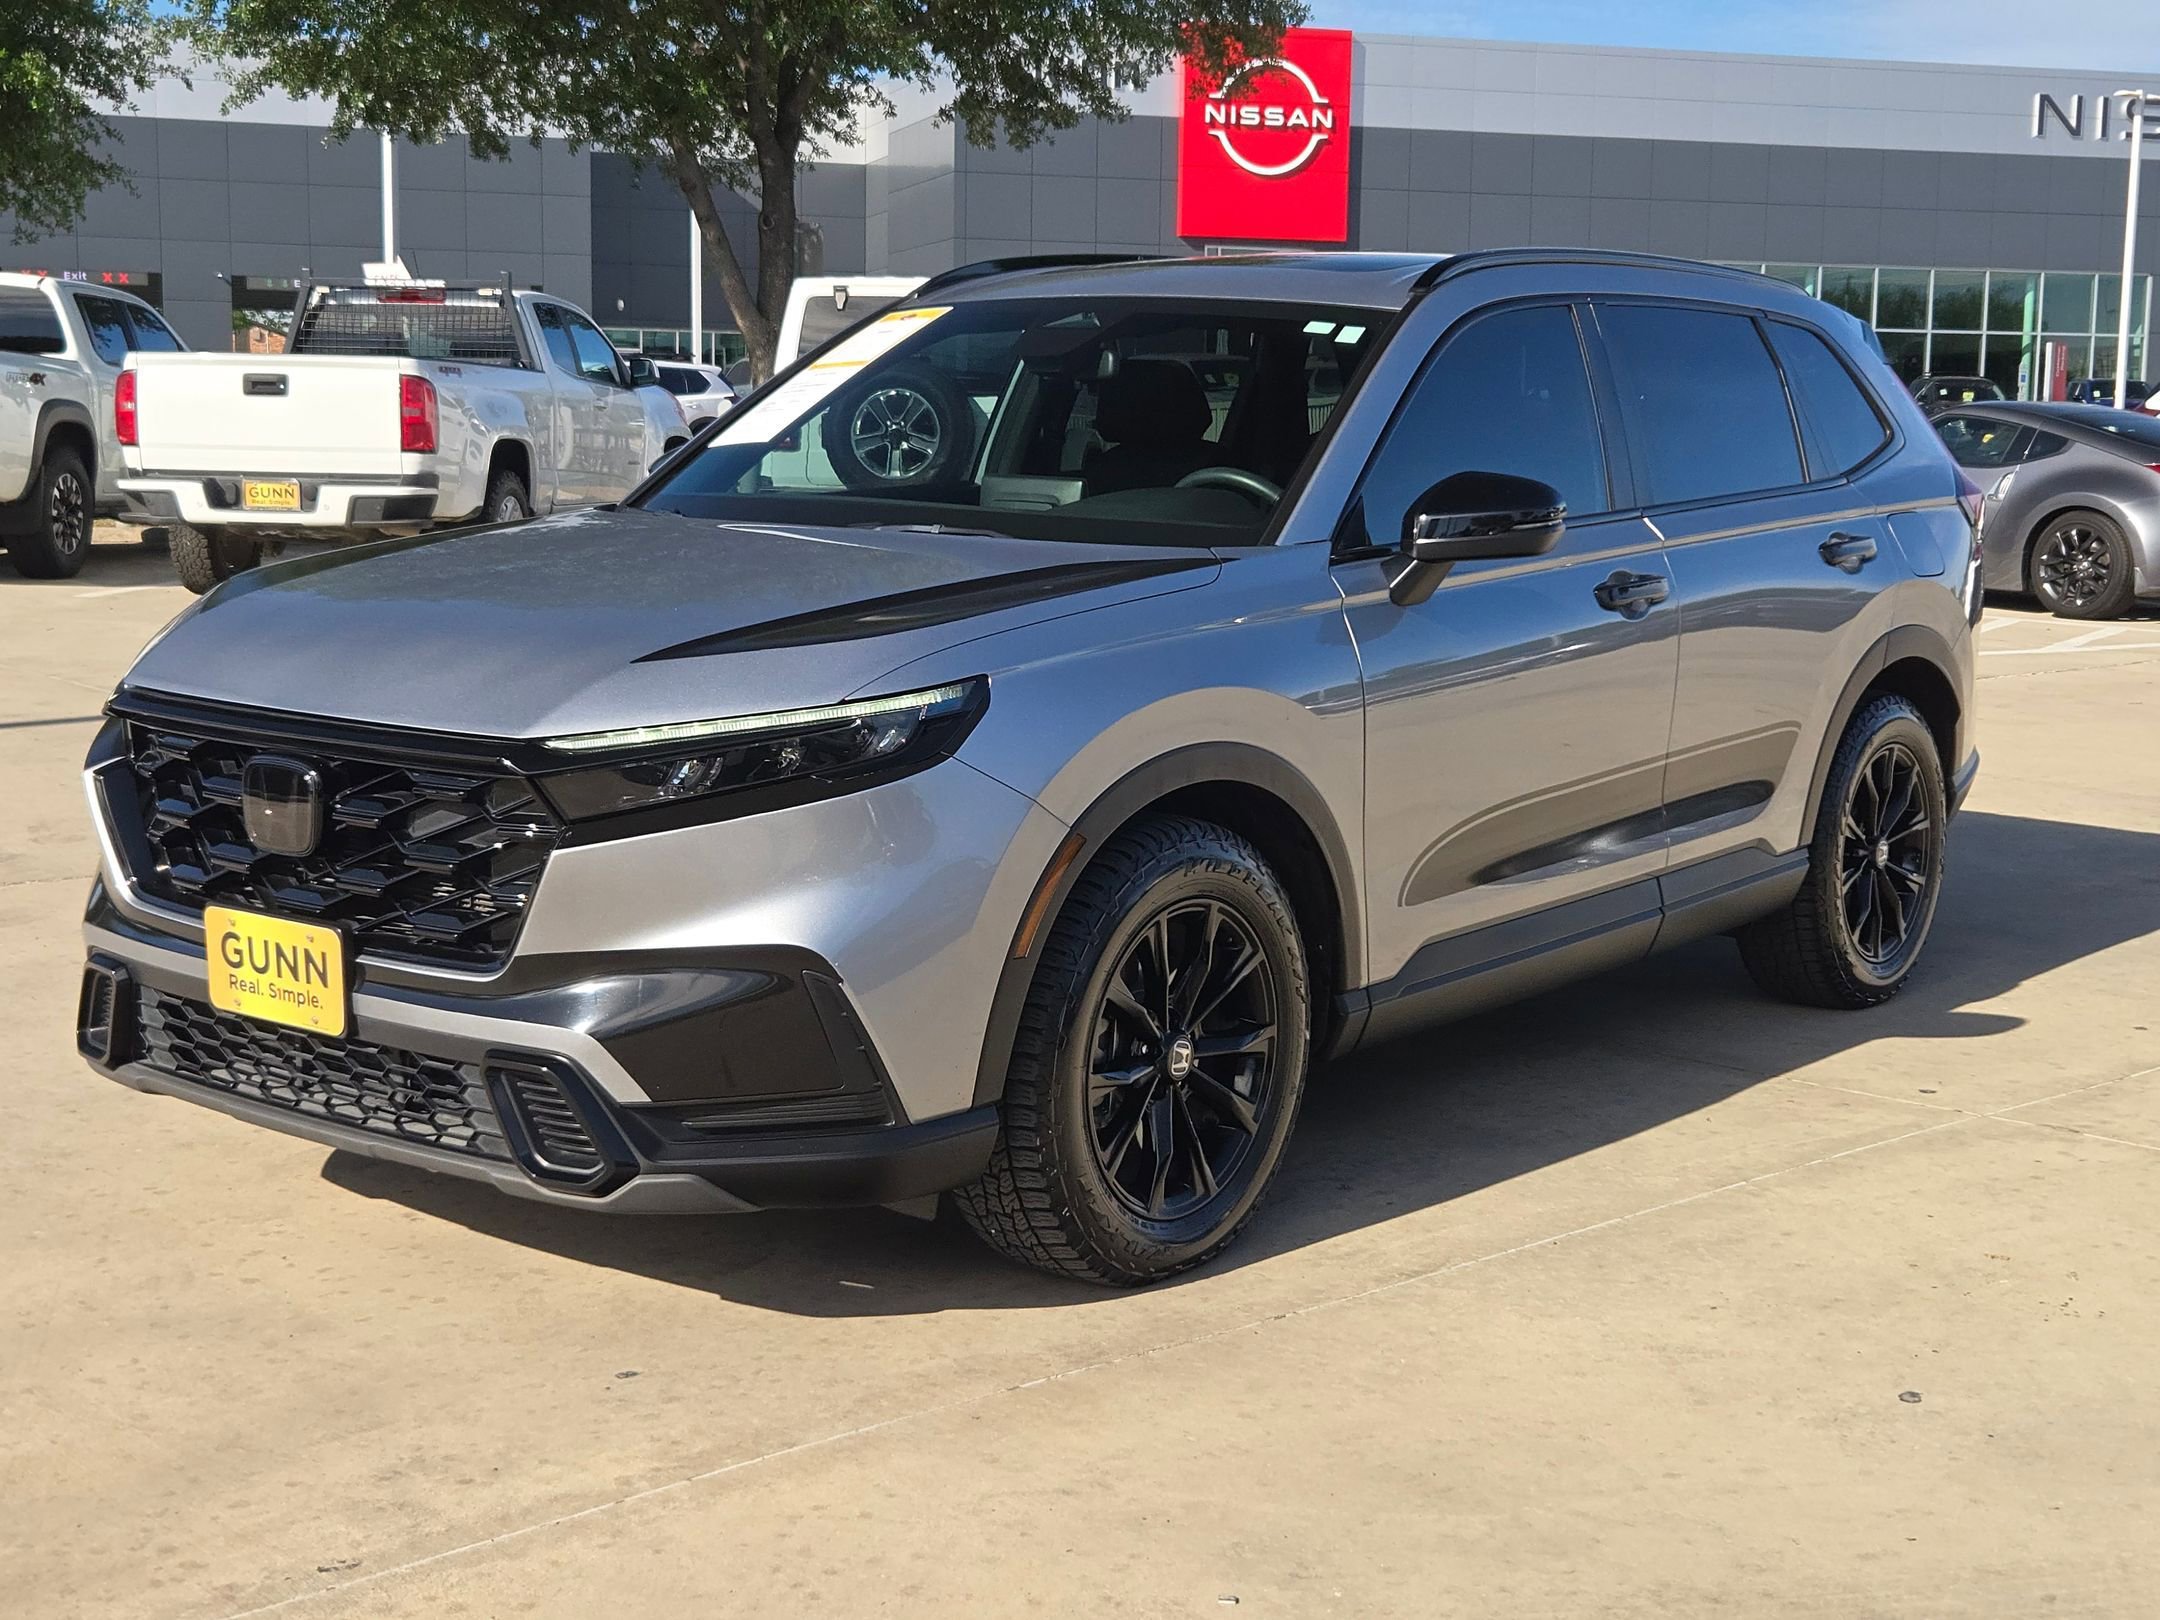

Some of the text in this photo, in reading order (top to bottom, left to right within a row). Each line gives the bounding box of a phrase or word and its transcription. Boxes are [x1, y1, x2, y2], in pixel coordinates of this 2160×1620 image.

[1204, 104, 1332, 129] NISSAN
[63, 271, 87, 282] Exit
[249, 486, 295, 499] GUNN
[221, 931, 329, 989] GUNN
[229, 974, 264, 996] Real.
